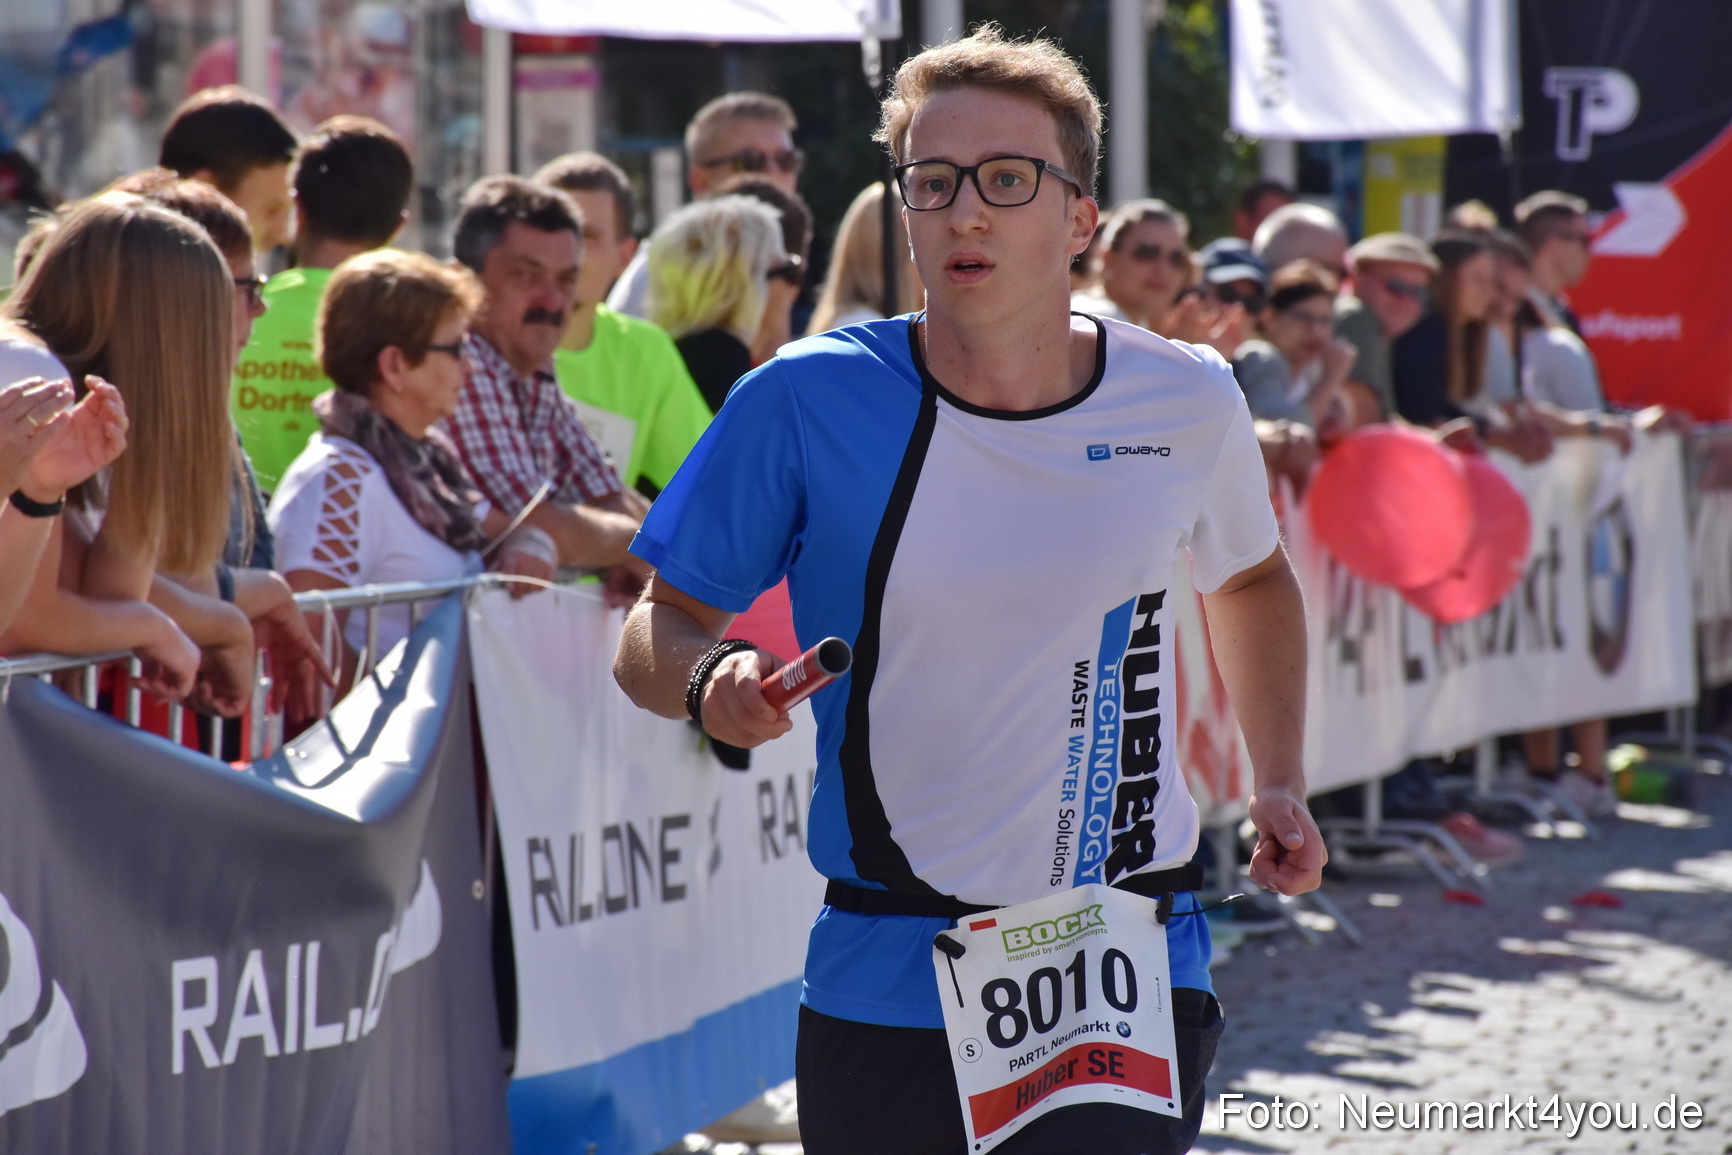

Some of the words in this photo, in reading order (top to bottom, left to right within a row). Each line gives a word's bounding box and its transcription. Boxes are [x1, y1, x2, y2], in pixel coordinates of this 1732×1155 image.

[1070, 659, 1090, 729] WASTE
[1060, 734, 1085, 803] WATER
[1081, 657, 1121, 878] TECHNOLOGY
[1104, 588, 1167, 887] HUBER
[1050, 807, 1075, 887] Solutions
[1001, 904, 1106, 953] BOCK
[1007, 948, 1041, 963] inspired
[1042, 945, 1053, 955] by
[1054, 938, 1076, 951] smart
[1076, 927, 1108, 942] concepts
[980, 947, 1138, 1049] 8010
[965, 1044, 976, 1057] S
[1009, 1045, 1049, 1072] PARTL
[1051, 1021, 1111, 1050] Neumarkt
[1016, 1056, 1079, 1110] Huber
[1087, 1049, 1125, 1078] SE
